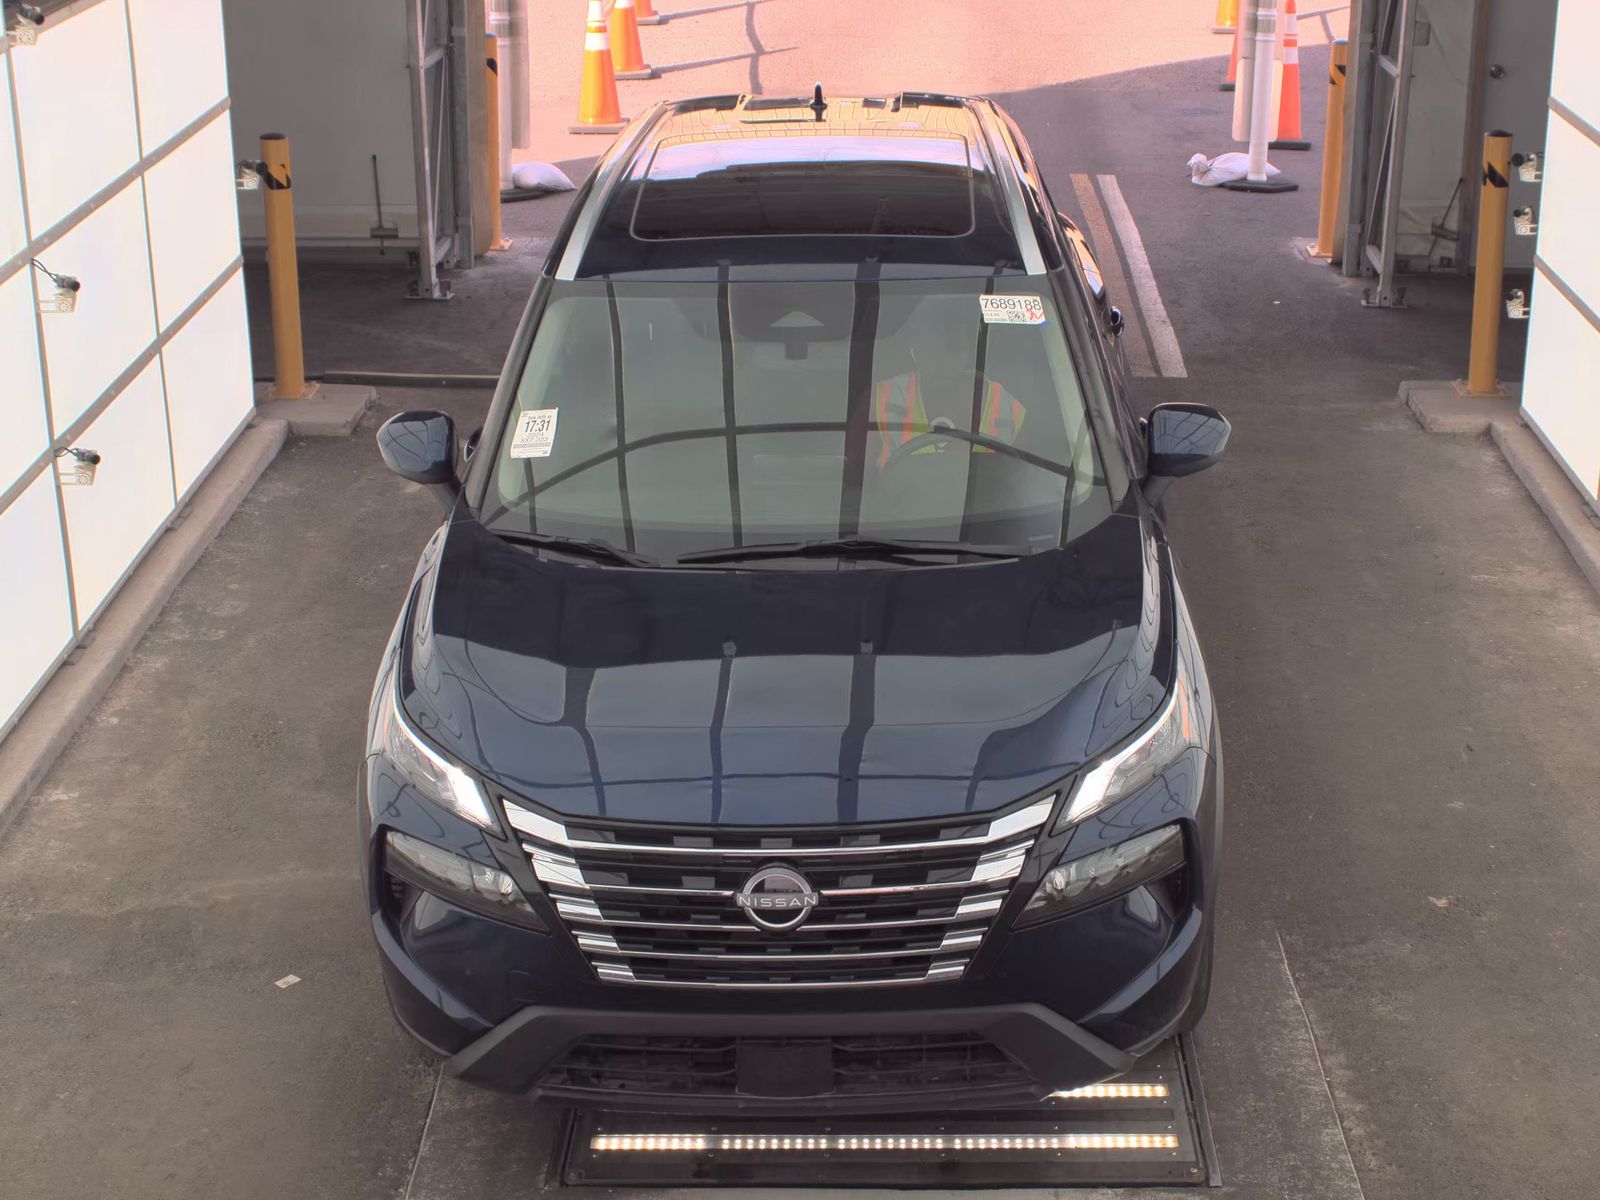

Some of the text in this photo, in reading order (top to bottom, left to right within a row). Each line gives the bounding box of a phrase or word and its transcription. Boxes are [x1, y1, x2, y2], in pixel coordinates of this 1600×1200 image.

[981, 298, 1042, 311] 7689188
[525, 419, 551, 433] 17:31
[739, 895, 817, 908] NISSAN
